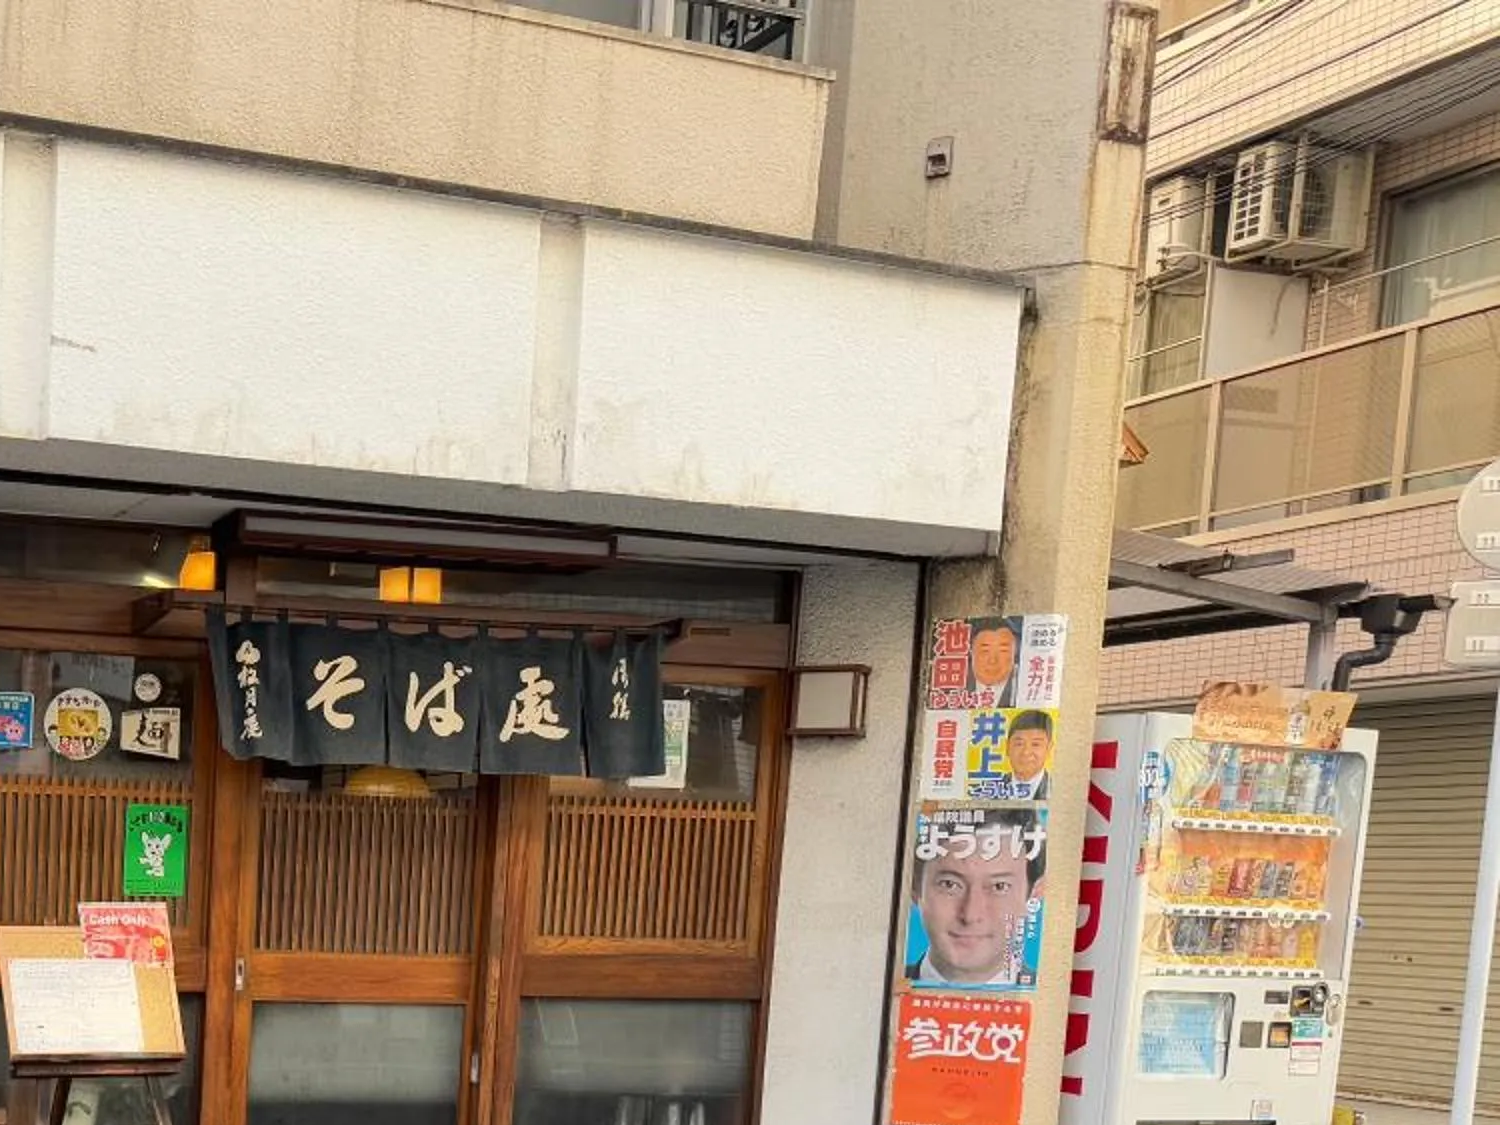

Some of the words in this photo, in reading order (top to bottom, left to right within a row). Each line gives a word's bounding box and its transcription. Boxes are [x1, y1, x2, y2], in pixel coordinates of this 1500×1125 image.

[932, 619, 972, 689] 池田
[932, 719, 958, 779] 自民党
[967, 711, 1006, 779] 井上
[967, 781, 1031, 800] こういち
[916, 823, 1047, 861] ようすけ
[902, 1016, 1025, 1064] 参政党
